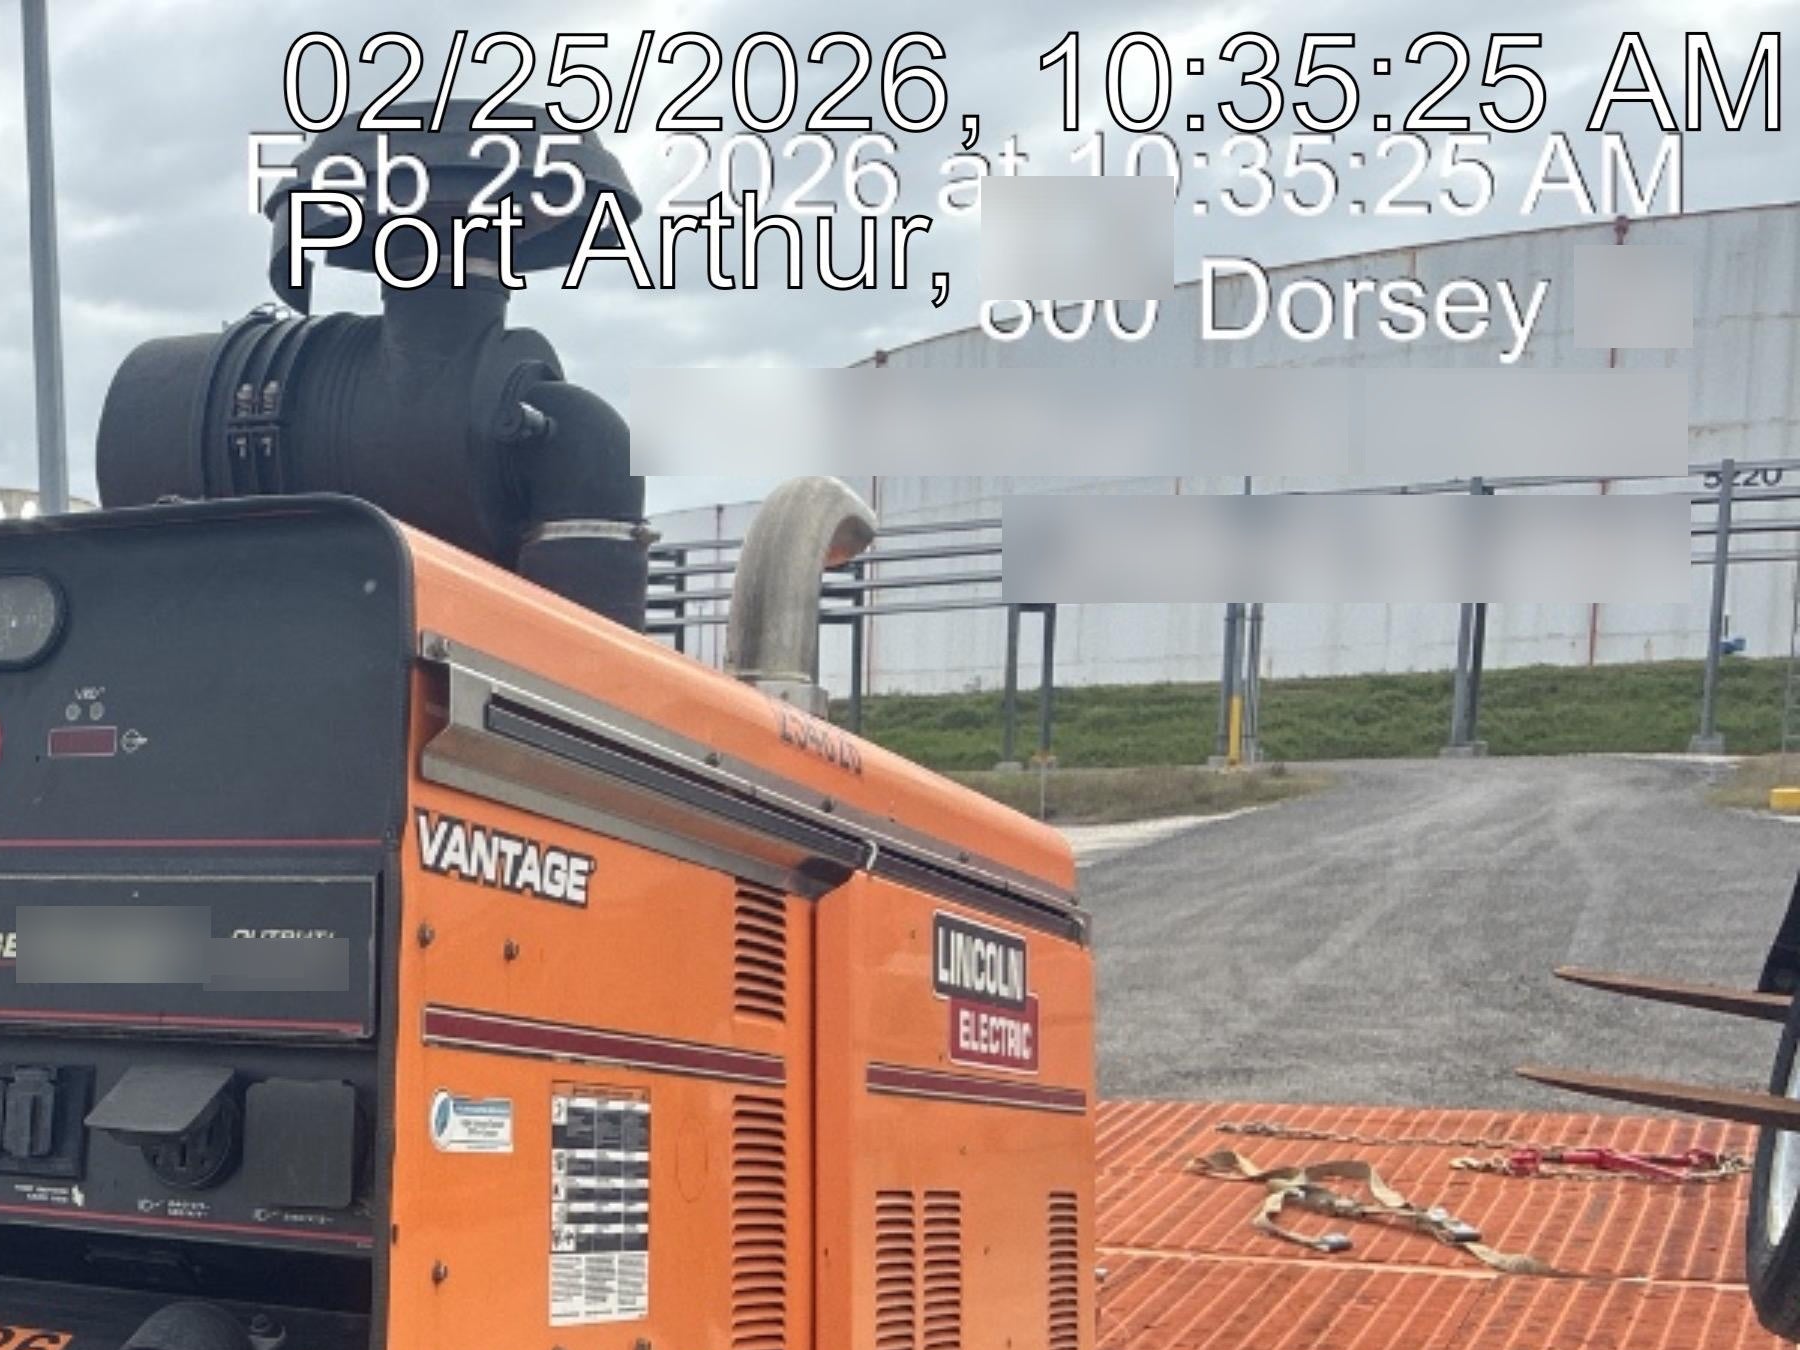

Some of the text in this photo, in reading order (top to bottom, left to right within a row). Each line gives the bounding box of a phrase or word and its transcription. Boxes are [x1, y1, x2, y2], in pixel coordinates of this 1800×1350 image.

[414, 810, 590, 908] VANTAGE
[937, 925, 1025, 1002] LINCOLN
[958, 1008, 1033, 1060] ELECTRIC
